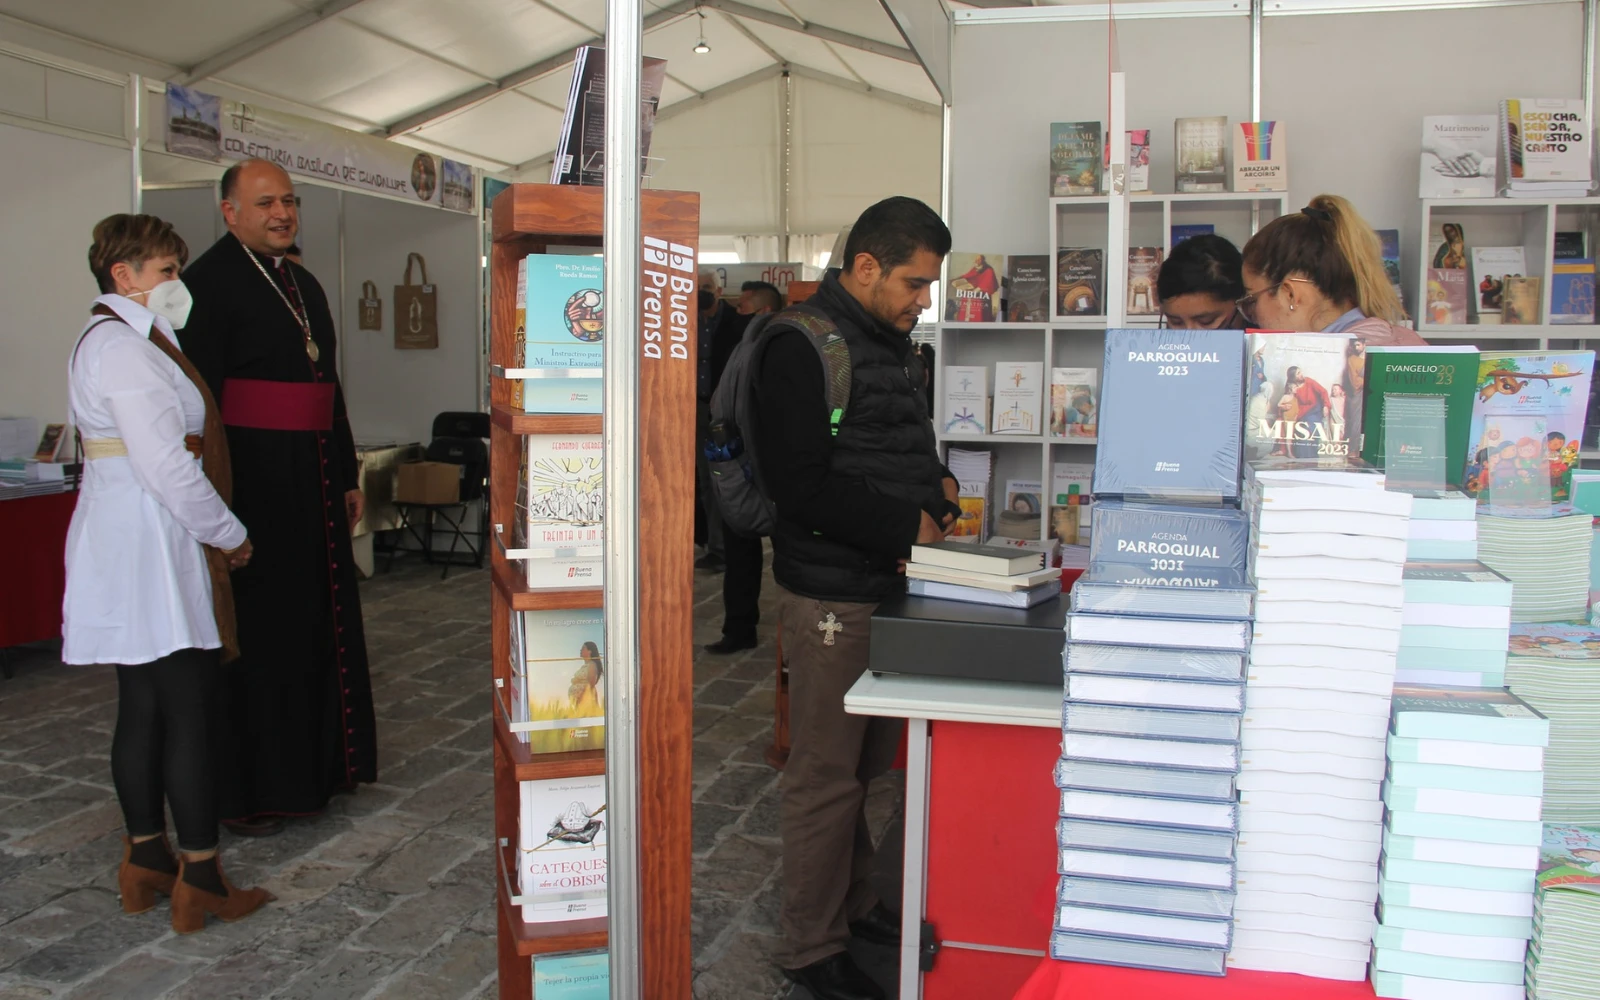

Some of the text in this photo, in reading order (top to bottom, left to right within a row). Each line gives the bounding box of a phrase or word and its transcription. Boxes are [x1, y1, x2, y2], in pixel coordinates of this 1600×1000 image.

[1433, 124, 1490, 132] Matrimonio
[1525, 132, 1583, 142] NUESTRO
[1525, 143, 1568, 153] CANTO
[343, 165, 356, 182] DE
[359, 170, 407, 194] GUADALUPE
[956, 288, 990, 300] BIBLIA
[643, 269, 668, 360] Prensa
[670, 275, 694, 360] Buena
[551, 348, 601, 360] Instructivo para
[1128, 351, 1220, 363] PARROQUIAL
[534, 357, 568, 366] Ministros
[1158, 366, 1188, 376] 2023
[1385, 364, 1438, 373] EVANGELIO
[1256, 419, 1350, 443] MISAL
[552, 442, 578, 450] FERNANDO
[1317, 443, 1349, 456] 2023
[543, 530, 573, 542] TREINTA
[577, 531, 582, 540] Y
[586, 530, 596, 541] UN
[1151, 532, 1188, 541] AGENDA
[1117, 539, 1220, 559] PARROQUIAL
[544, 978, 563, 987] Tejer
[574, 973, 599, 984] propia
